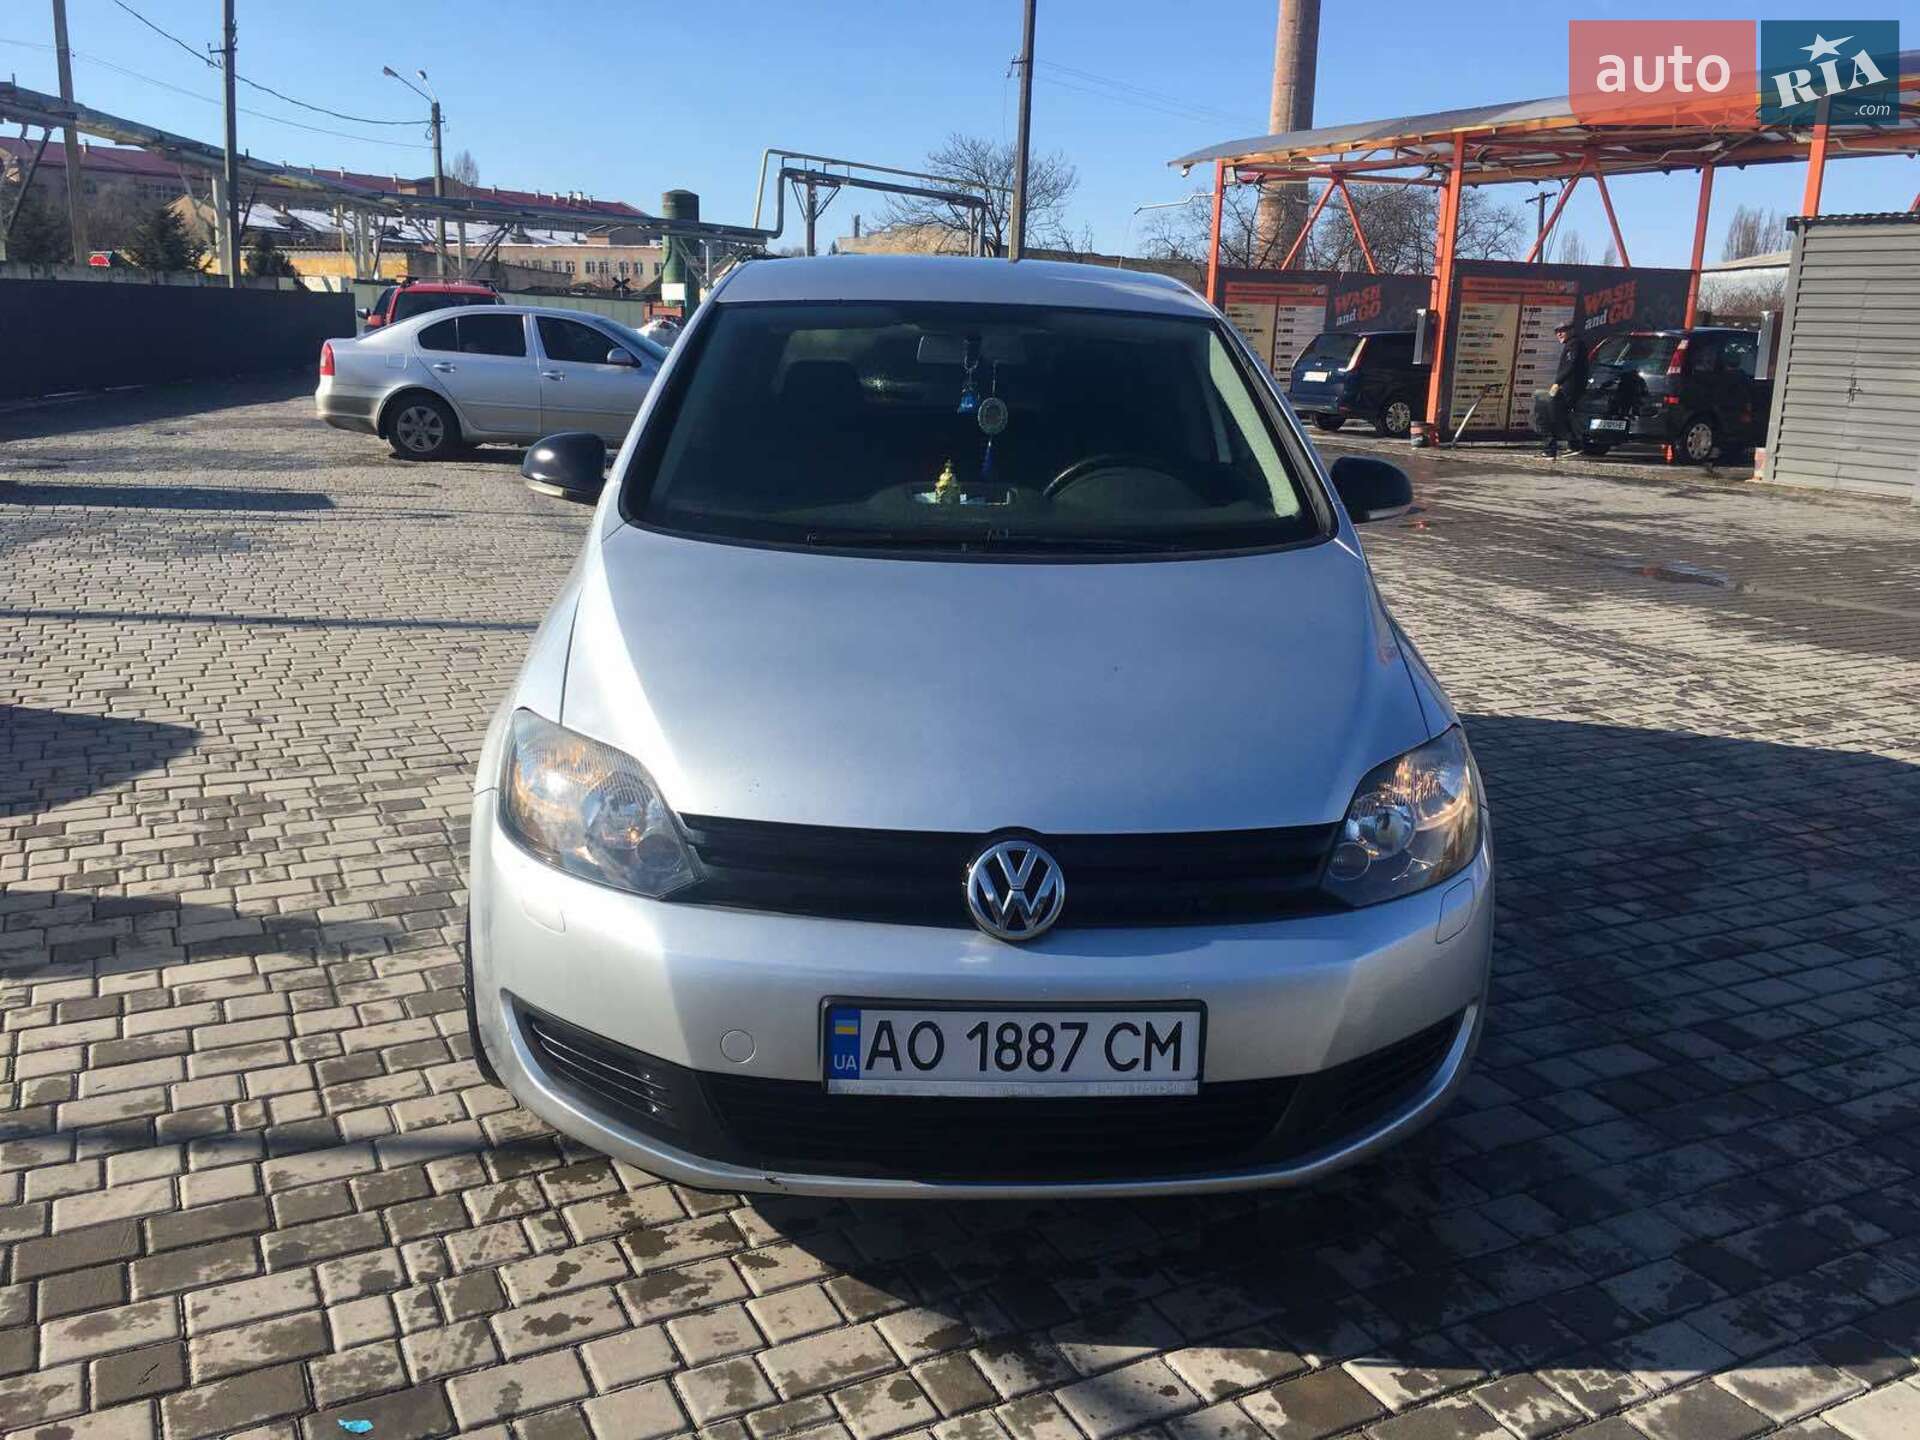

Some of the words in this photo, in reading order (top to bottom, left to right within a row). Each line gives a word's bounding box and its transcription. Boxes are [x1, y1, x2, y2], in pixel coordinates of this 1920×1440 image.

[1584, 281, 1637, 315] WASH
[1336, 309, 1357, 326] and
[1585, 308, 1608, 330] and
[1608, 300, 1635, 325] GO
[865, 1020, 944, 1072] AO
[966, 1021, 1089, 1072] 1887
[1104, 1021, 1183, 1072] CM
[833, 1055, 858, 1071] UA
